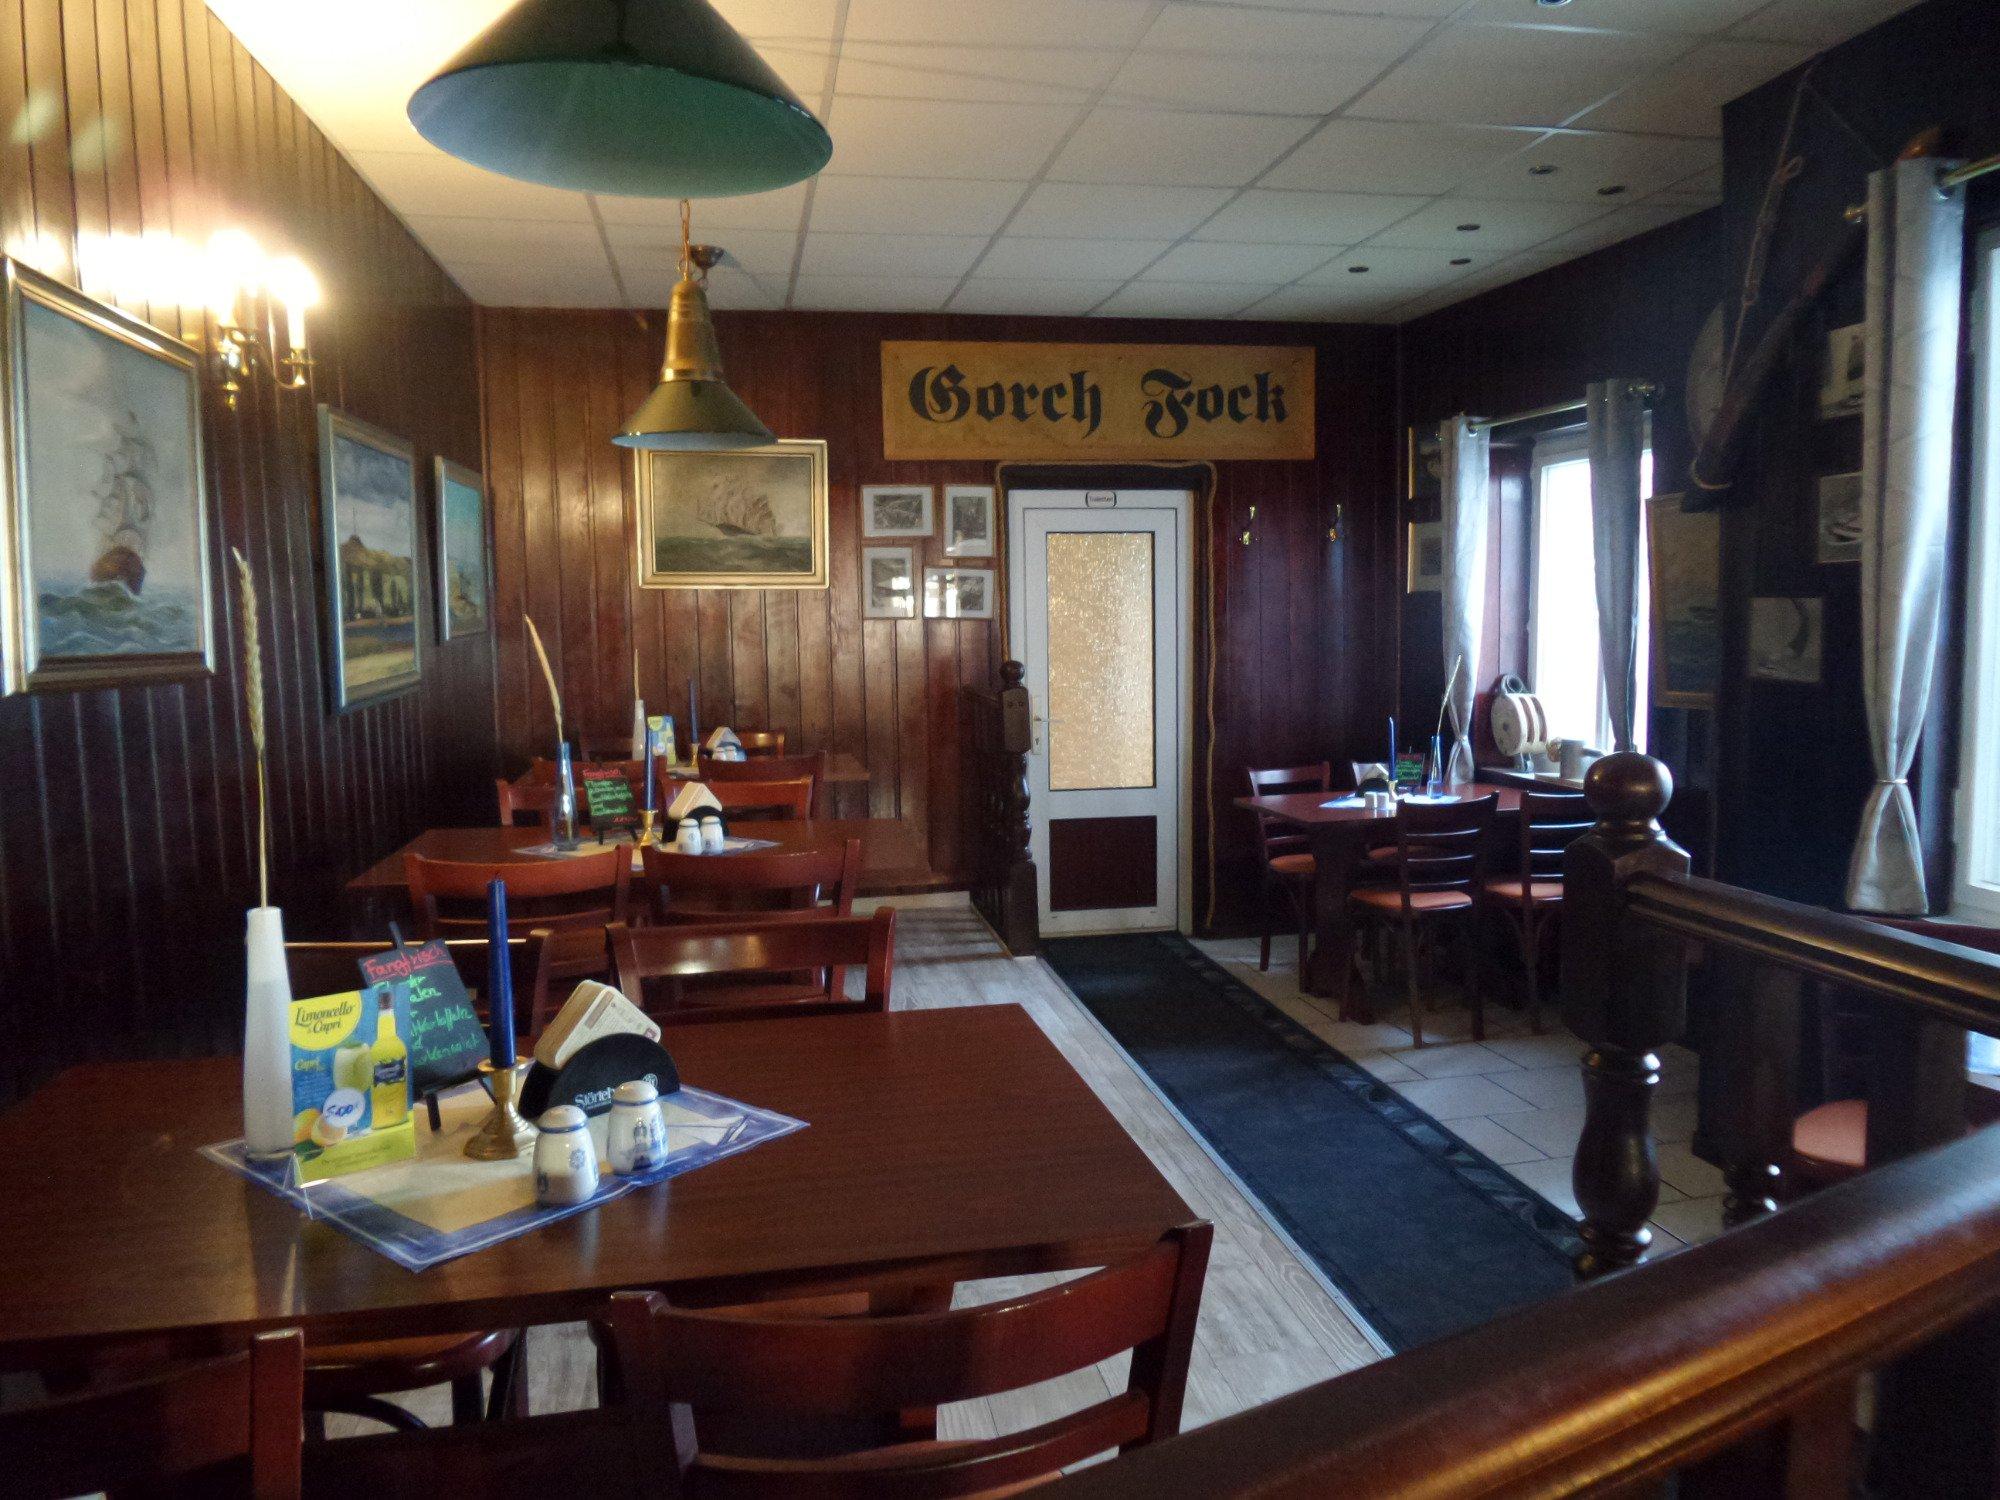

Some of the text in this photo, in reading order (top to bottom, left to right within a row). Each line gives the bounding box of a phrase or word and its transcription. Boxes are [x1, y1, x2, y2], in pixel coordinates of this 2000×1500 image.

[908, 364, 1289, 439] Gorch Fock
[295, 1001, 354, 1026] Limoncello
[313, 1018, 342, 1034] Capri
